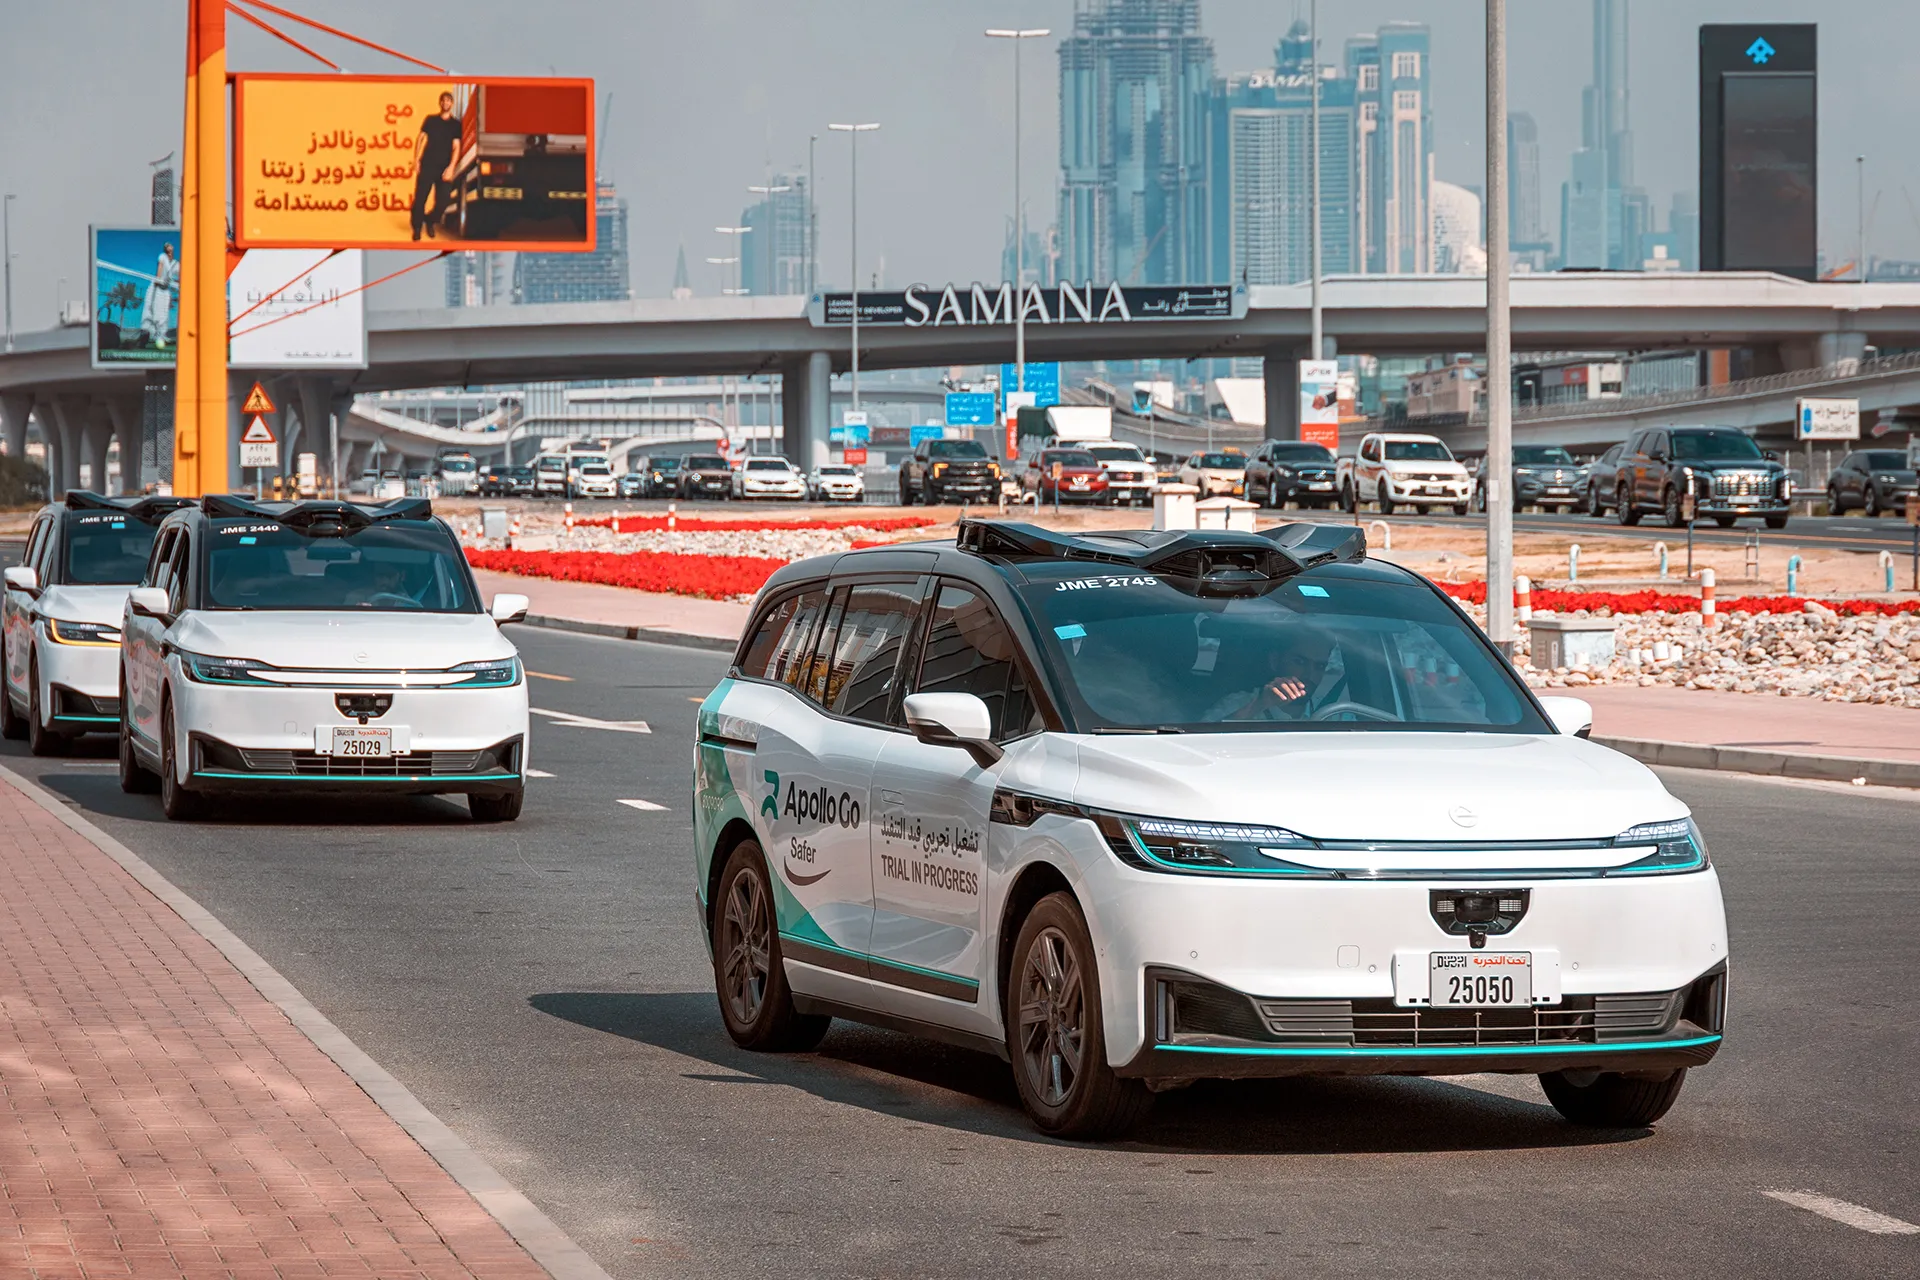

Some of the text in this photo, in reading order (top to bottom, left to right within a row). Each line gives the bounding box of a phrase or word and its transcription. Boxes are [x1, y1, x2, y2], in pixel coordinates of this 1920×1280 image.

[384, 103, 413, 124] مع
[307, 130, 413, 155] ماكدونالدز
[261, 159, 414, 185] نعيد تدوير زيتنا
[254, 189, 349, 212] مستدامة
[905, 280, 1132, 327] SAMANA
[220, 524, 279, 534] JME 2440
[1055, 577, 1157, 592] JME 2745
[343, 740, 381, 755] 25029
[784, 781, 861, 829] Apollo Go
[881, 813, 979, 859] تشغيل تجريبي قيد التنفيذ
[790, 836, 817, 864] Safer
[881, 854, 979, 896] TRIAL IN PROGRESS
[1473, 955, 1526, 967] تحت التجربة
[1449, 975, 1514, 1004] 25050
